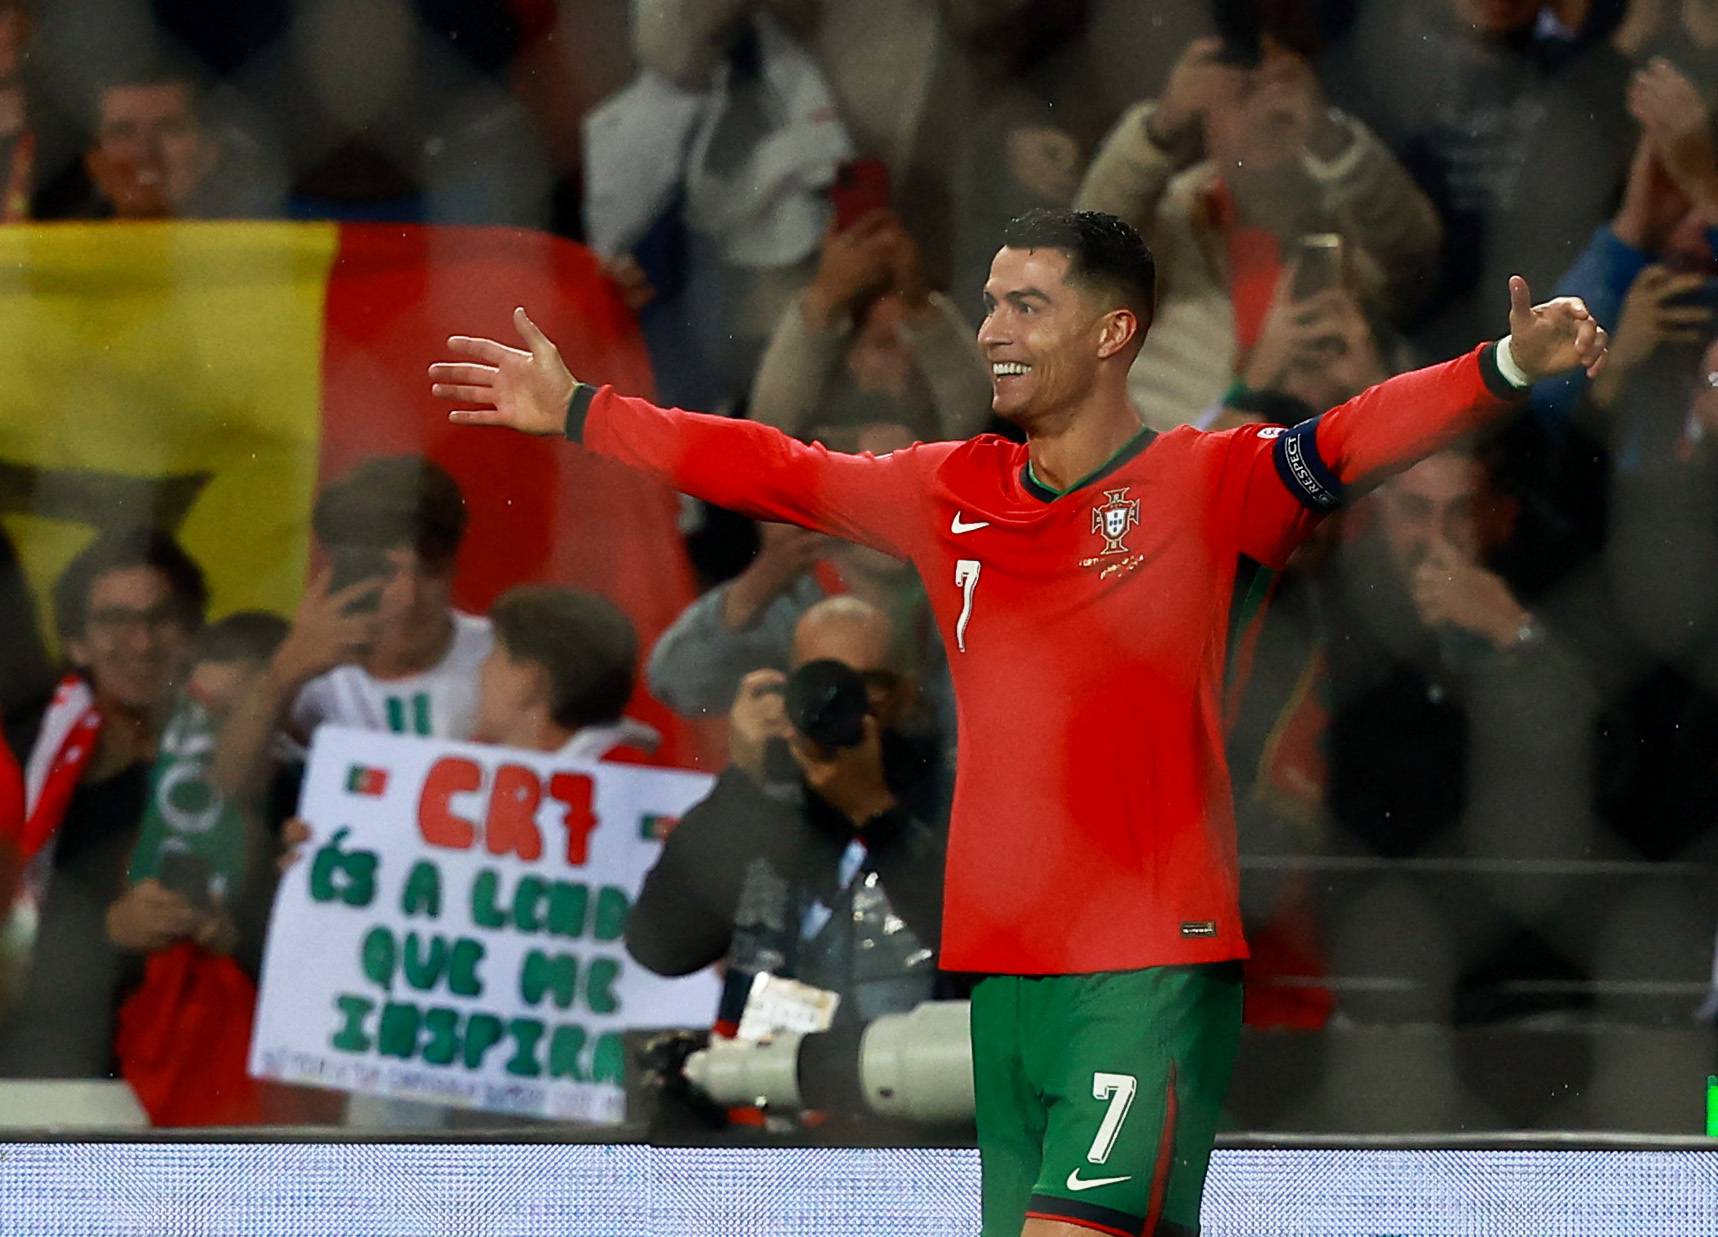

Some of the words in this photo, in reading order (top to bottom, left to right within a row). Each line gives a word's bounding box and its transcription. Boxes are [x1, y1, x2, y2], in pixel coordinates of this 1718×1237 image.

[1288, 437, 1320, 493] RESPECT
[956, 560, 981, 653] 7
[417, 757, 596, 867] CR7
[404, 861, 442, 918] A
[472, 869, 628, 941] LEND
[362, 926, 486, 998] QUE
[522, 949, 623, 1015] ME
[1087, 1072, 1137, 1164] 7
